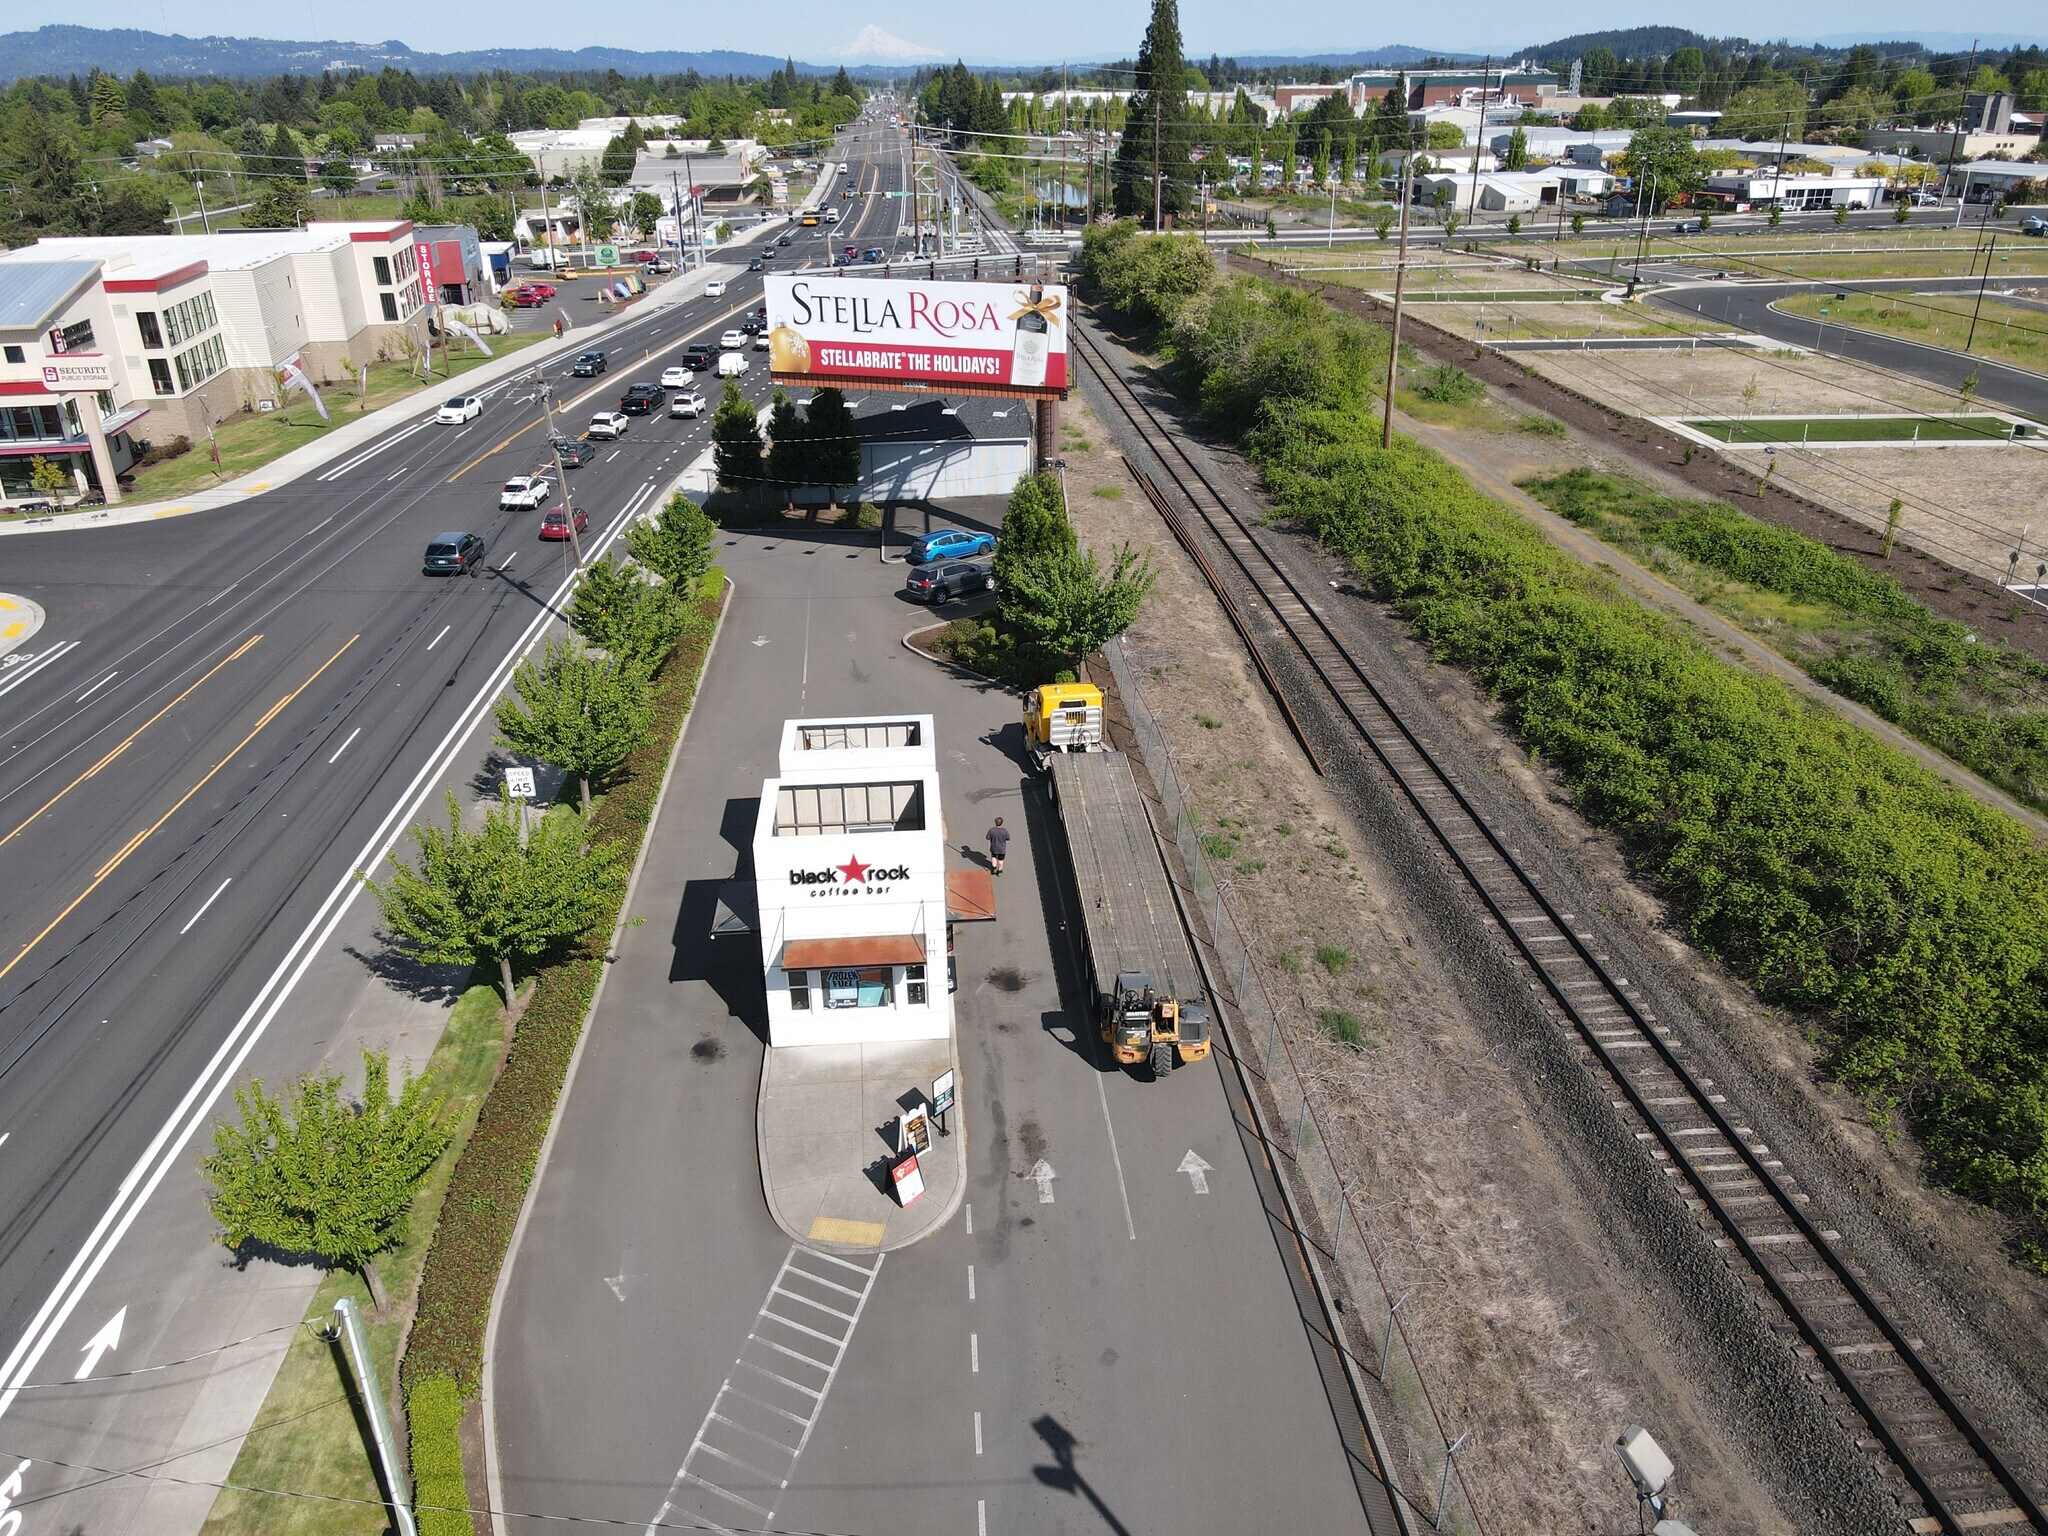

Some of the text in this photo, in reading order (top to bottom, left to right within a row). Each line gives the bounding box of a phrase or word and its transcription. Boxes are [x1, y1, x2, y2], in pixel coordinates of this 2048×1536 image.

[419, 245, 435, 302] STORAGE
[792, 282, 902, 333] STELLA
[908, 352, 931, 371] THE
[933, 354, 1001, 375] HOLIDAYS!
[59, 366, 107, 375] SECURITY
[512, 783, 532, 793] 45
[789, 864, 910, 886] black rock
[810, 885, 891, 898] coffee bar
[828, 971, 859, 981] FROZEN
[833, 980, 854, 988] FUEL
